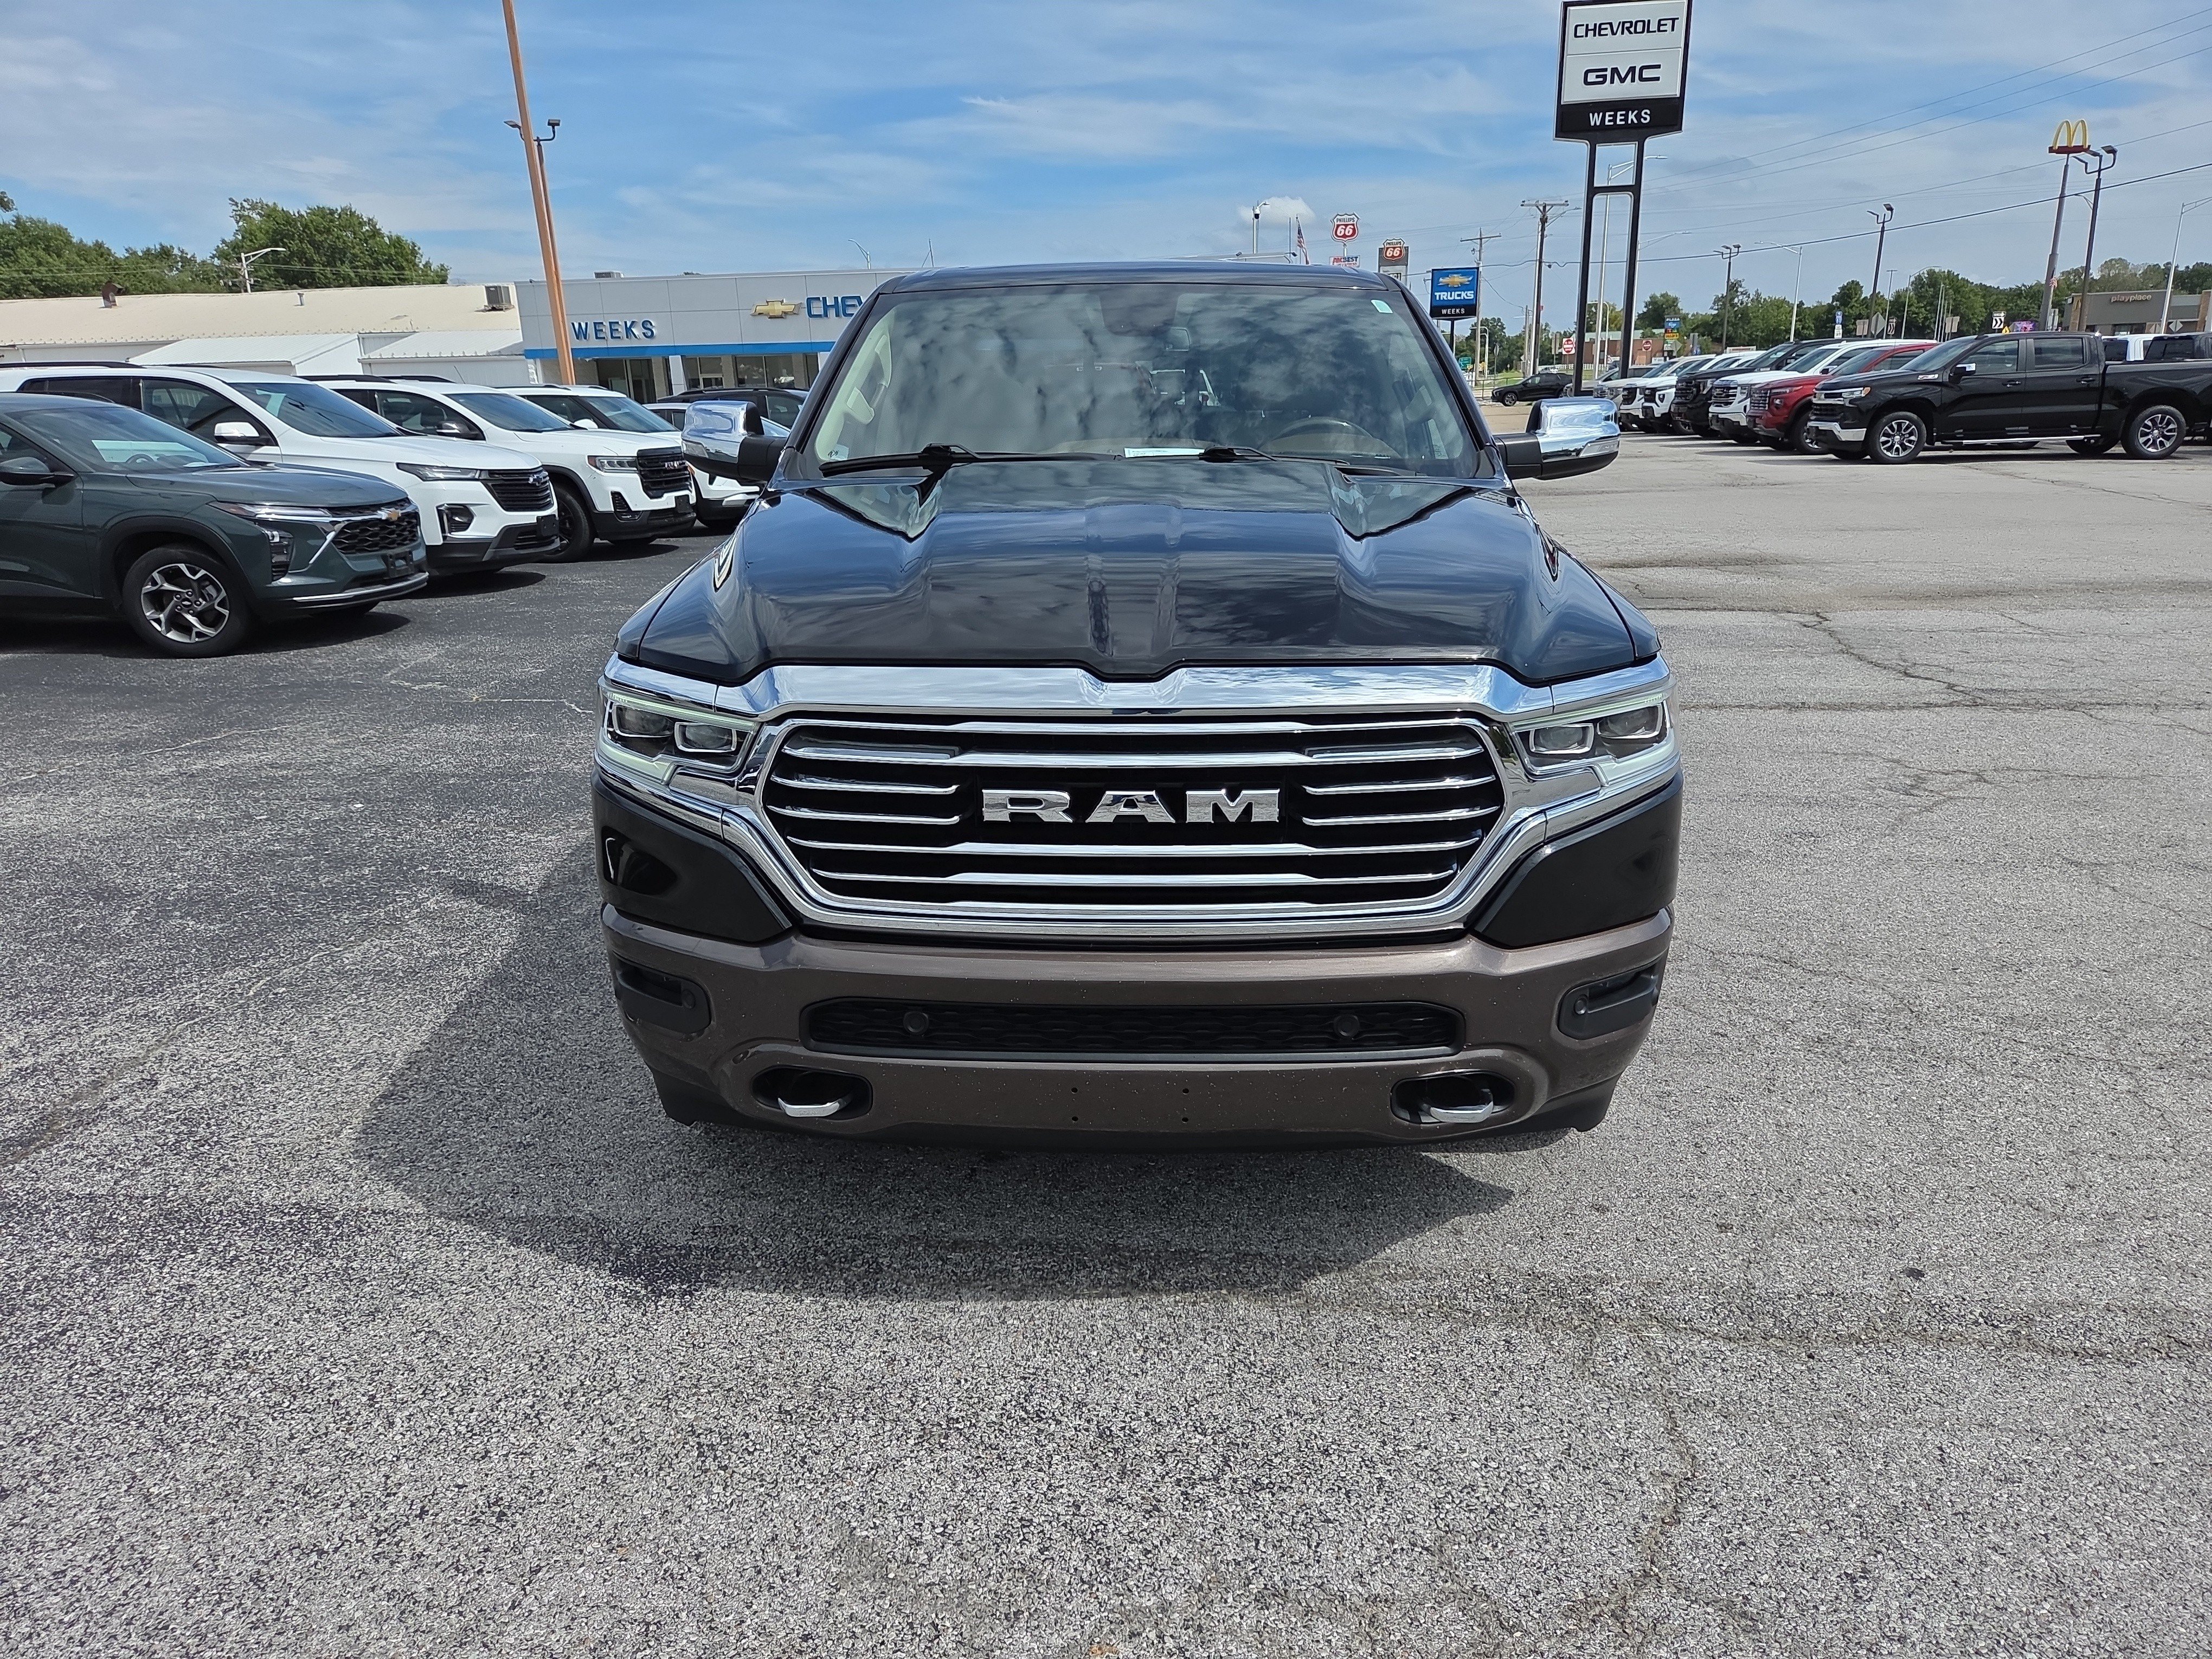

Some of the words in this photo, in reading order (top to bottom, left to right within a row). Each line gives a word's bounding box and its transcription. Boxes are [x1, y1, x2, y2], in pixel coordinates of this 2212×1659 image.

[1573, 17, 1680, 38] CHEVROLET
[1583, 64, 1662, 86] GMC
[1589, 109, 1651, 127] WEEKS
[1336, 225, 1354, 236] 66
[1386, 247, 1401, 257] 66
[1434, 291, 1474, 300] TRUCKS
[2111, 293, 2152, 303] playplace
[571, 319, 657, 341] WEEKS
[981, 788, 1281, 824] RAM
